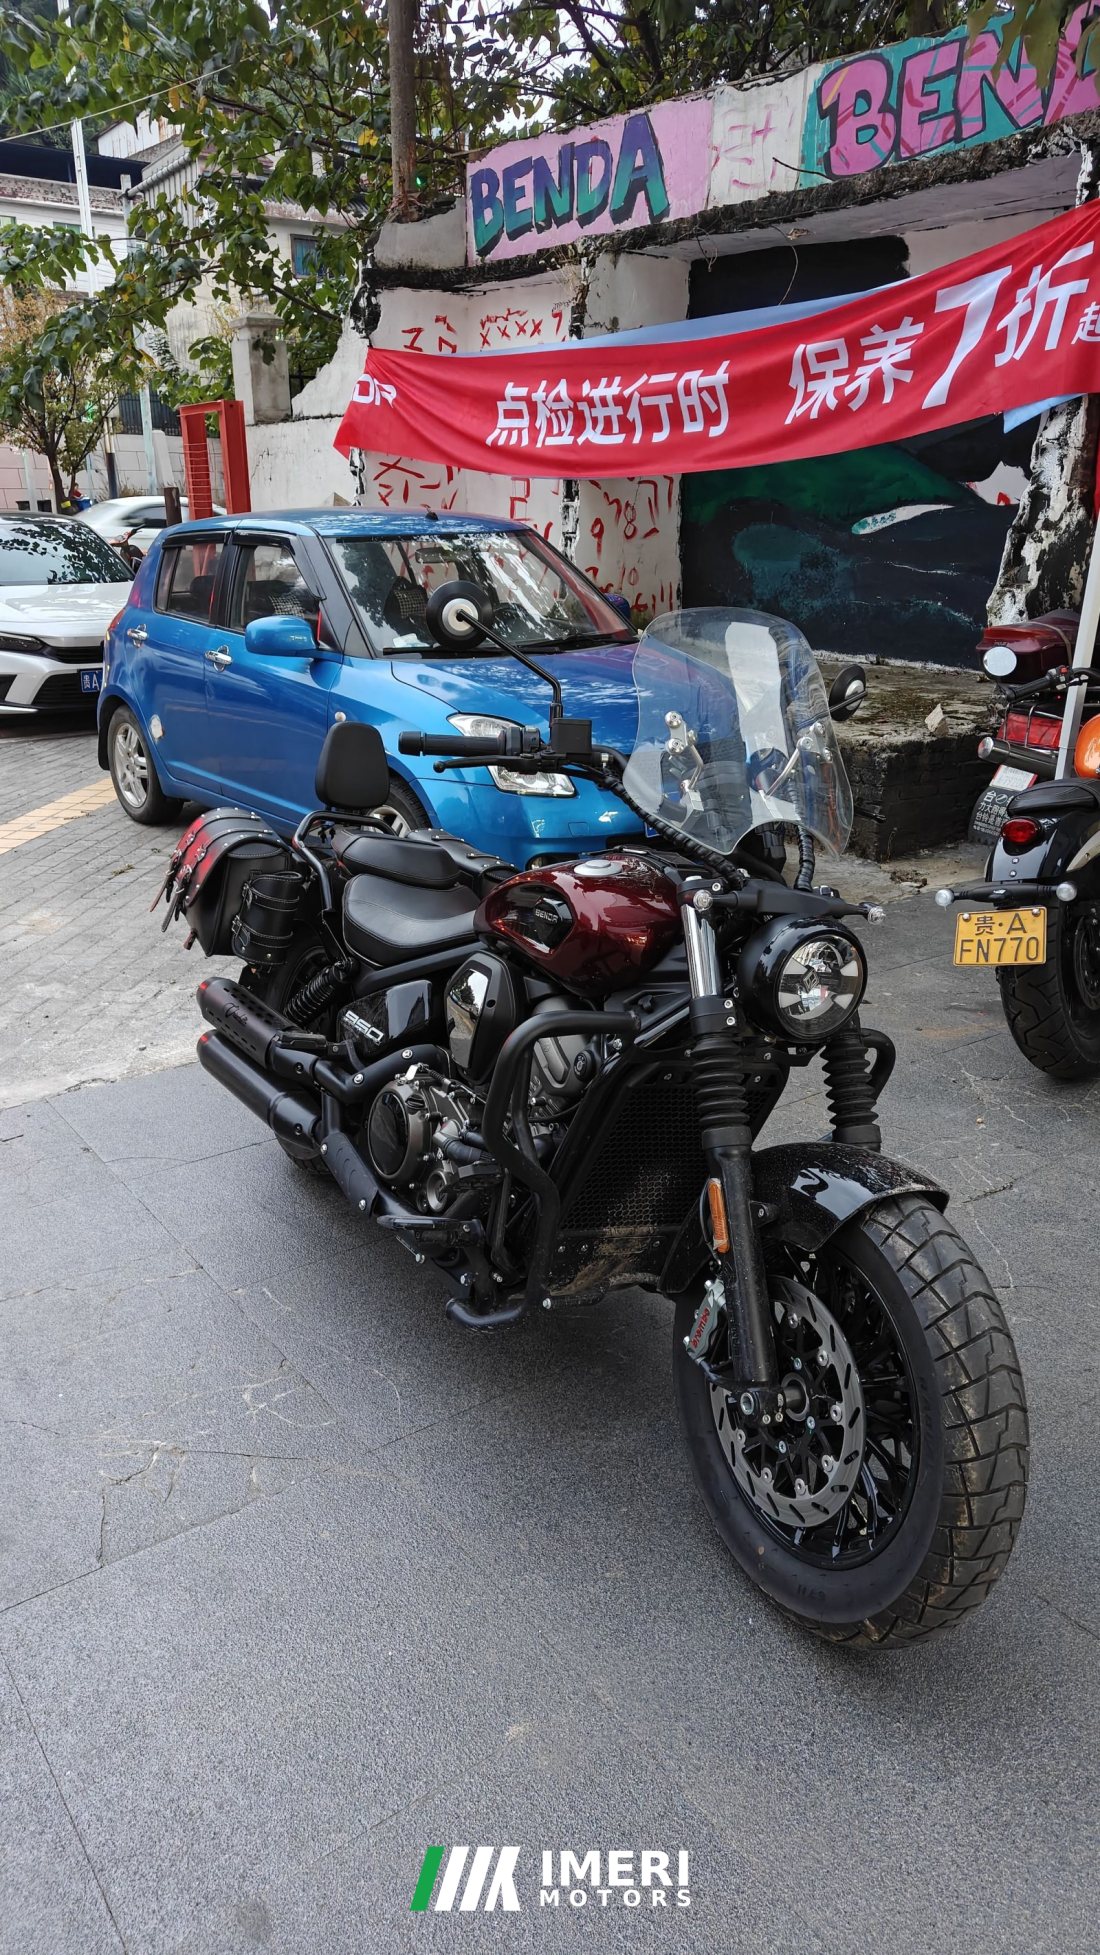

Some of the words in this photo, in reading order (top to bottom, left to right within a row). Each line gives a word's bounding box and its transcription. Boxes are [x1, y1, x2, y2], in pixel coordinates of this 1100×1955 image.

[470, 111, 671, 257] BENDA
[486, 360, 730, 448] 点检进行时
[959, 936, 1040, 963] FN770
[343, 1010, 384, 1043] 950
[690, 1306, 711, 1349] brembo
